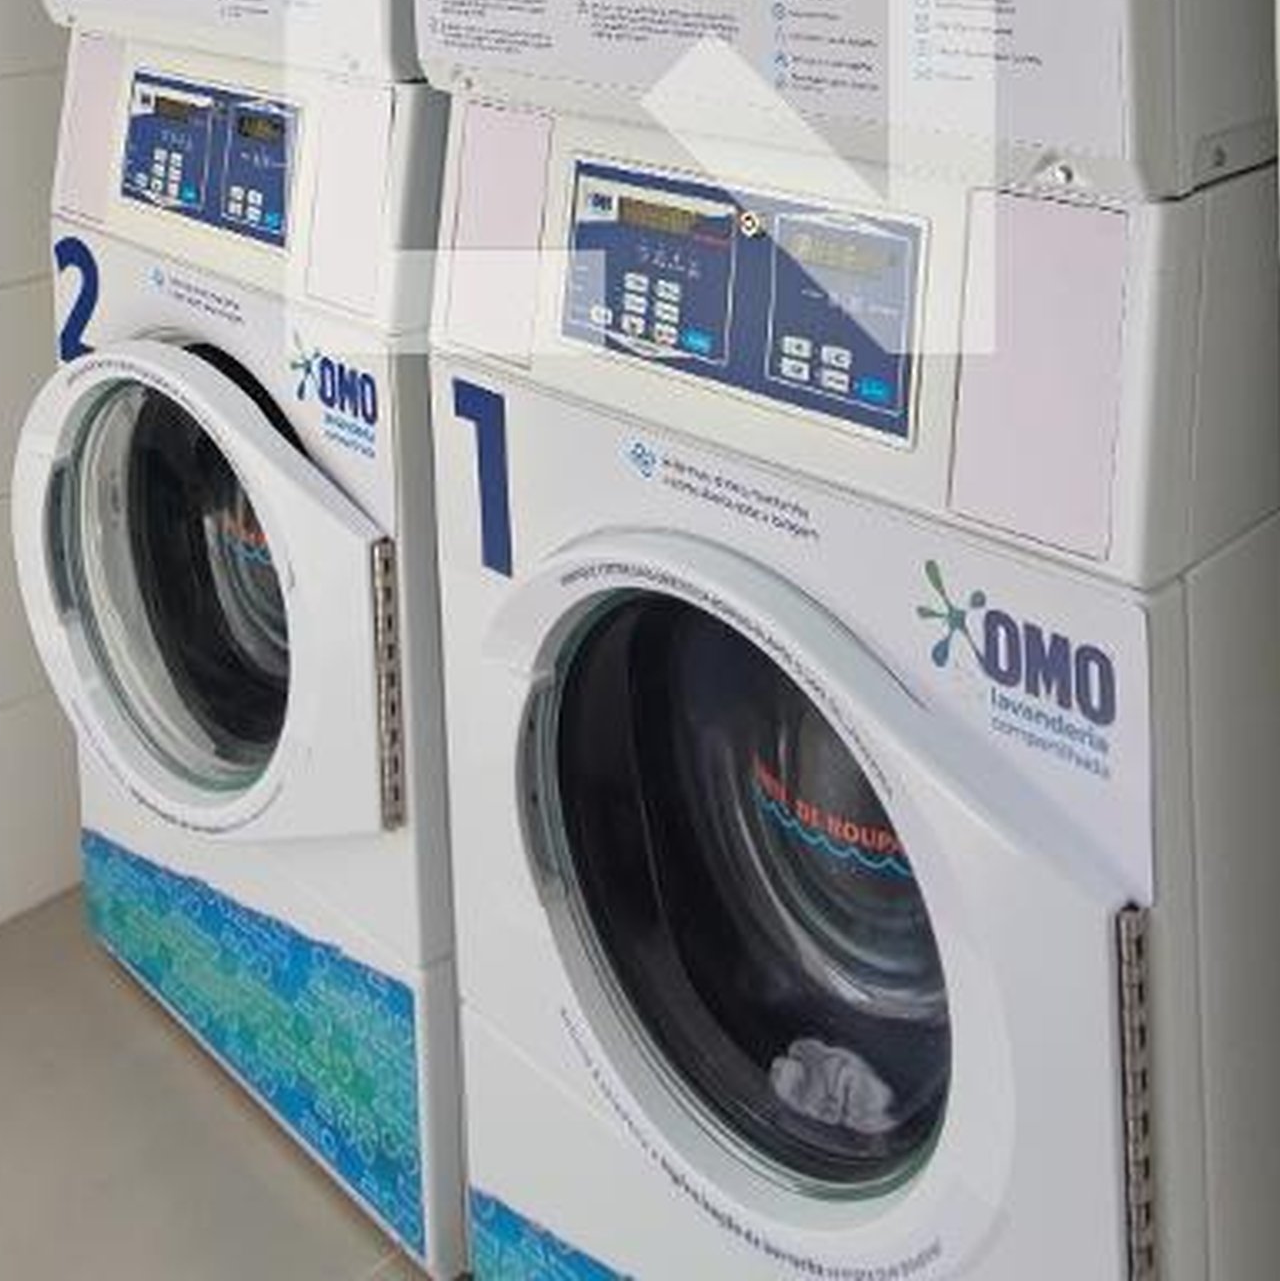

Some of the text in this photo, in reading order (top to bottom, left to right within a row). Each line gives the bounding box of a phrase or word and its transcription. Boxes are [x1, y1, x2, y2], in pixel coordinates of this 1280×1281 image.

[53, 236, 99, 363] 2
[318, 355, 379, 427] OMO
[451, 377, 513, 578] 1
[983, 609, 1117, 727] OMO
[990, 686, 1110, 755] lavanderia
